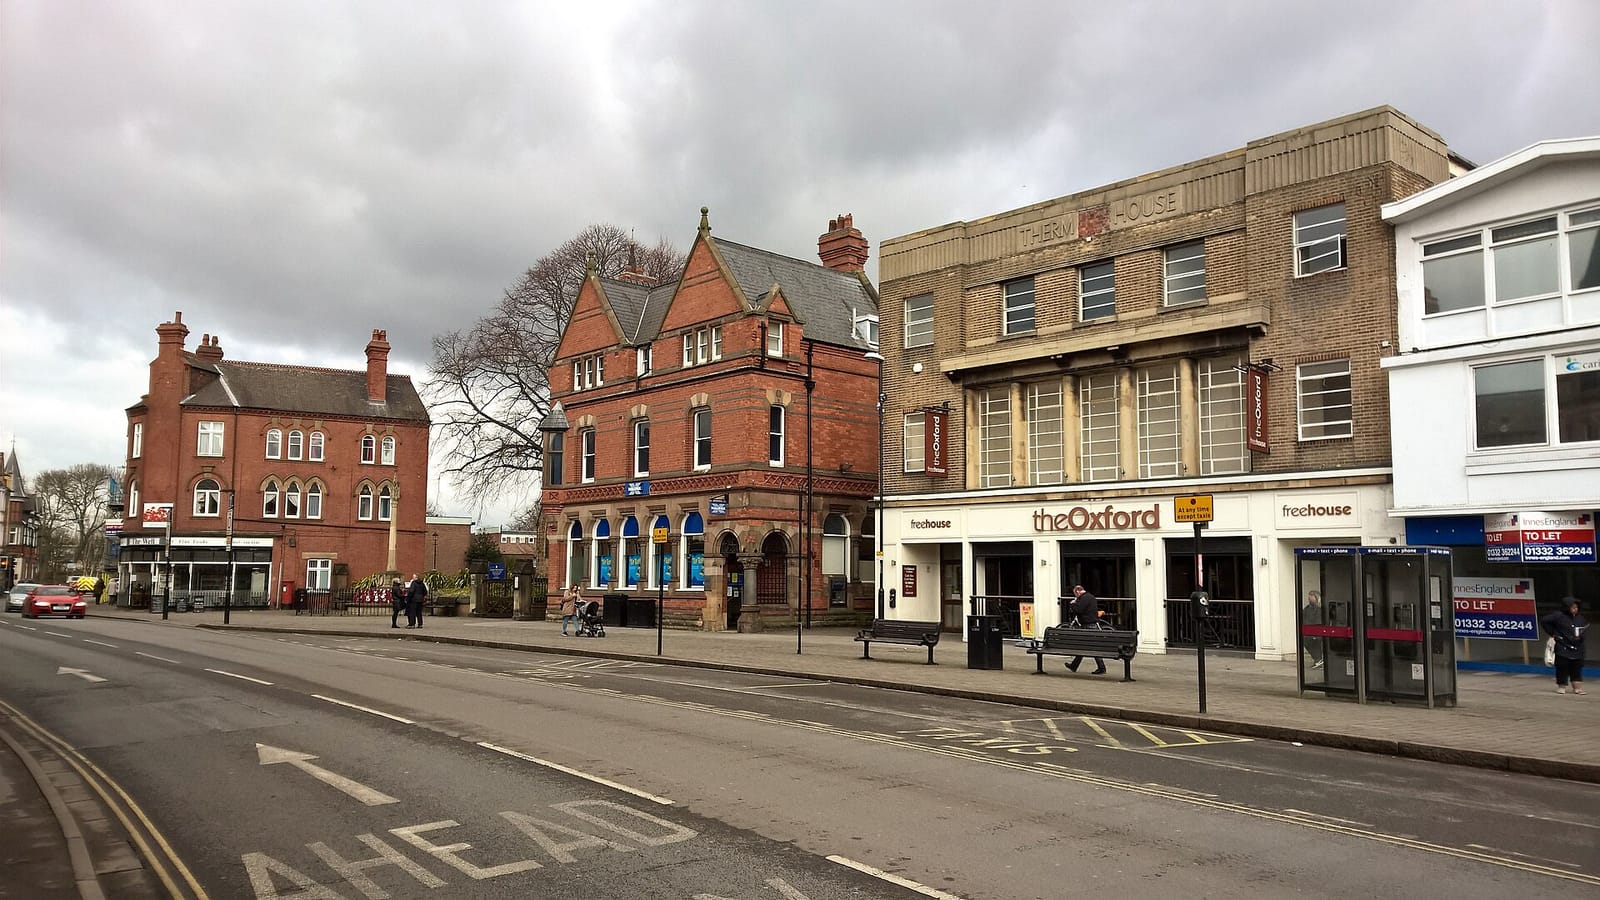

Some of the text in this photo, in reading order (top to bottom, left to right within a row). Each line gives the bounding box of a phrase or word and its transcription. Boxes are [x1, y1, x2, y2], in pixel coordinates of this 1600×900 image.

[1020, 192, 1177, 247] THERM HOUSE
[1583, 361, 1600, 369] car
[1282, 504, 1352, 517] freehouse
[1032, 503, 1160, 532] theOxford
[1522, 516, 1577, 528] InnesEngland
[910, 519, 952, 529] freehouse
[1524, 531, 1562, 541] TO LET
[1525, 547, 1593, 556] 01332 362244
[1454, 584, 1513, 596] nnesEngland
[1454, 600, 1496, 610] TO LET
[1454, 618, 1533, 630] 01332 362244
[241, 798, 699, 900] AHEAD
